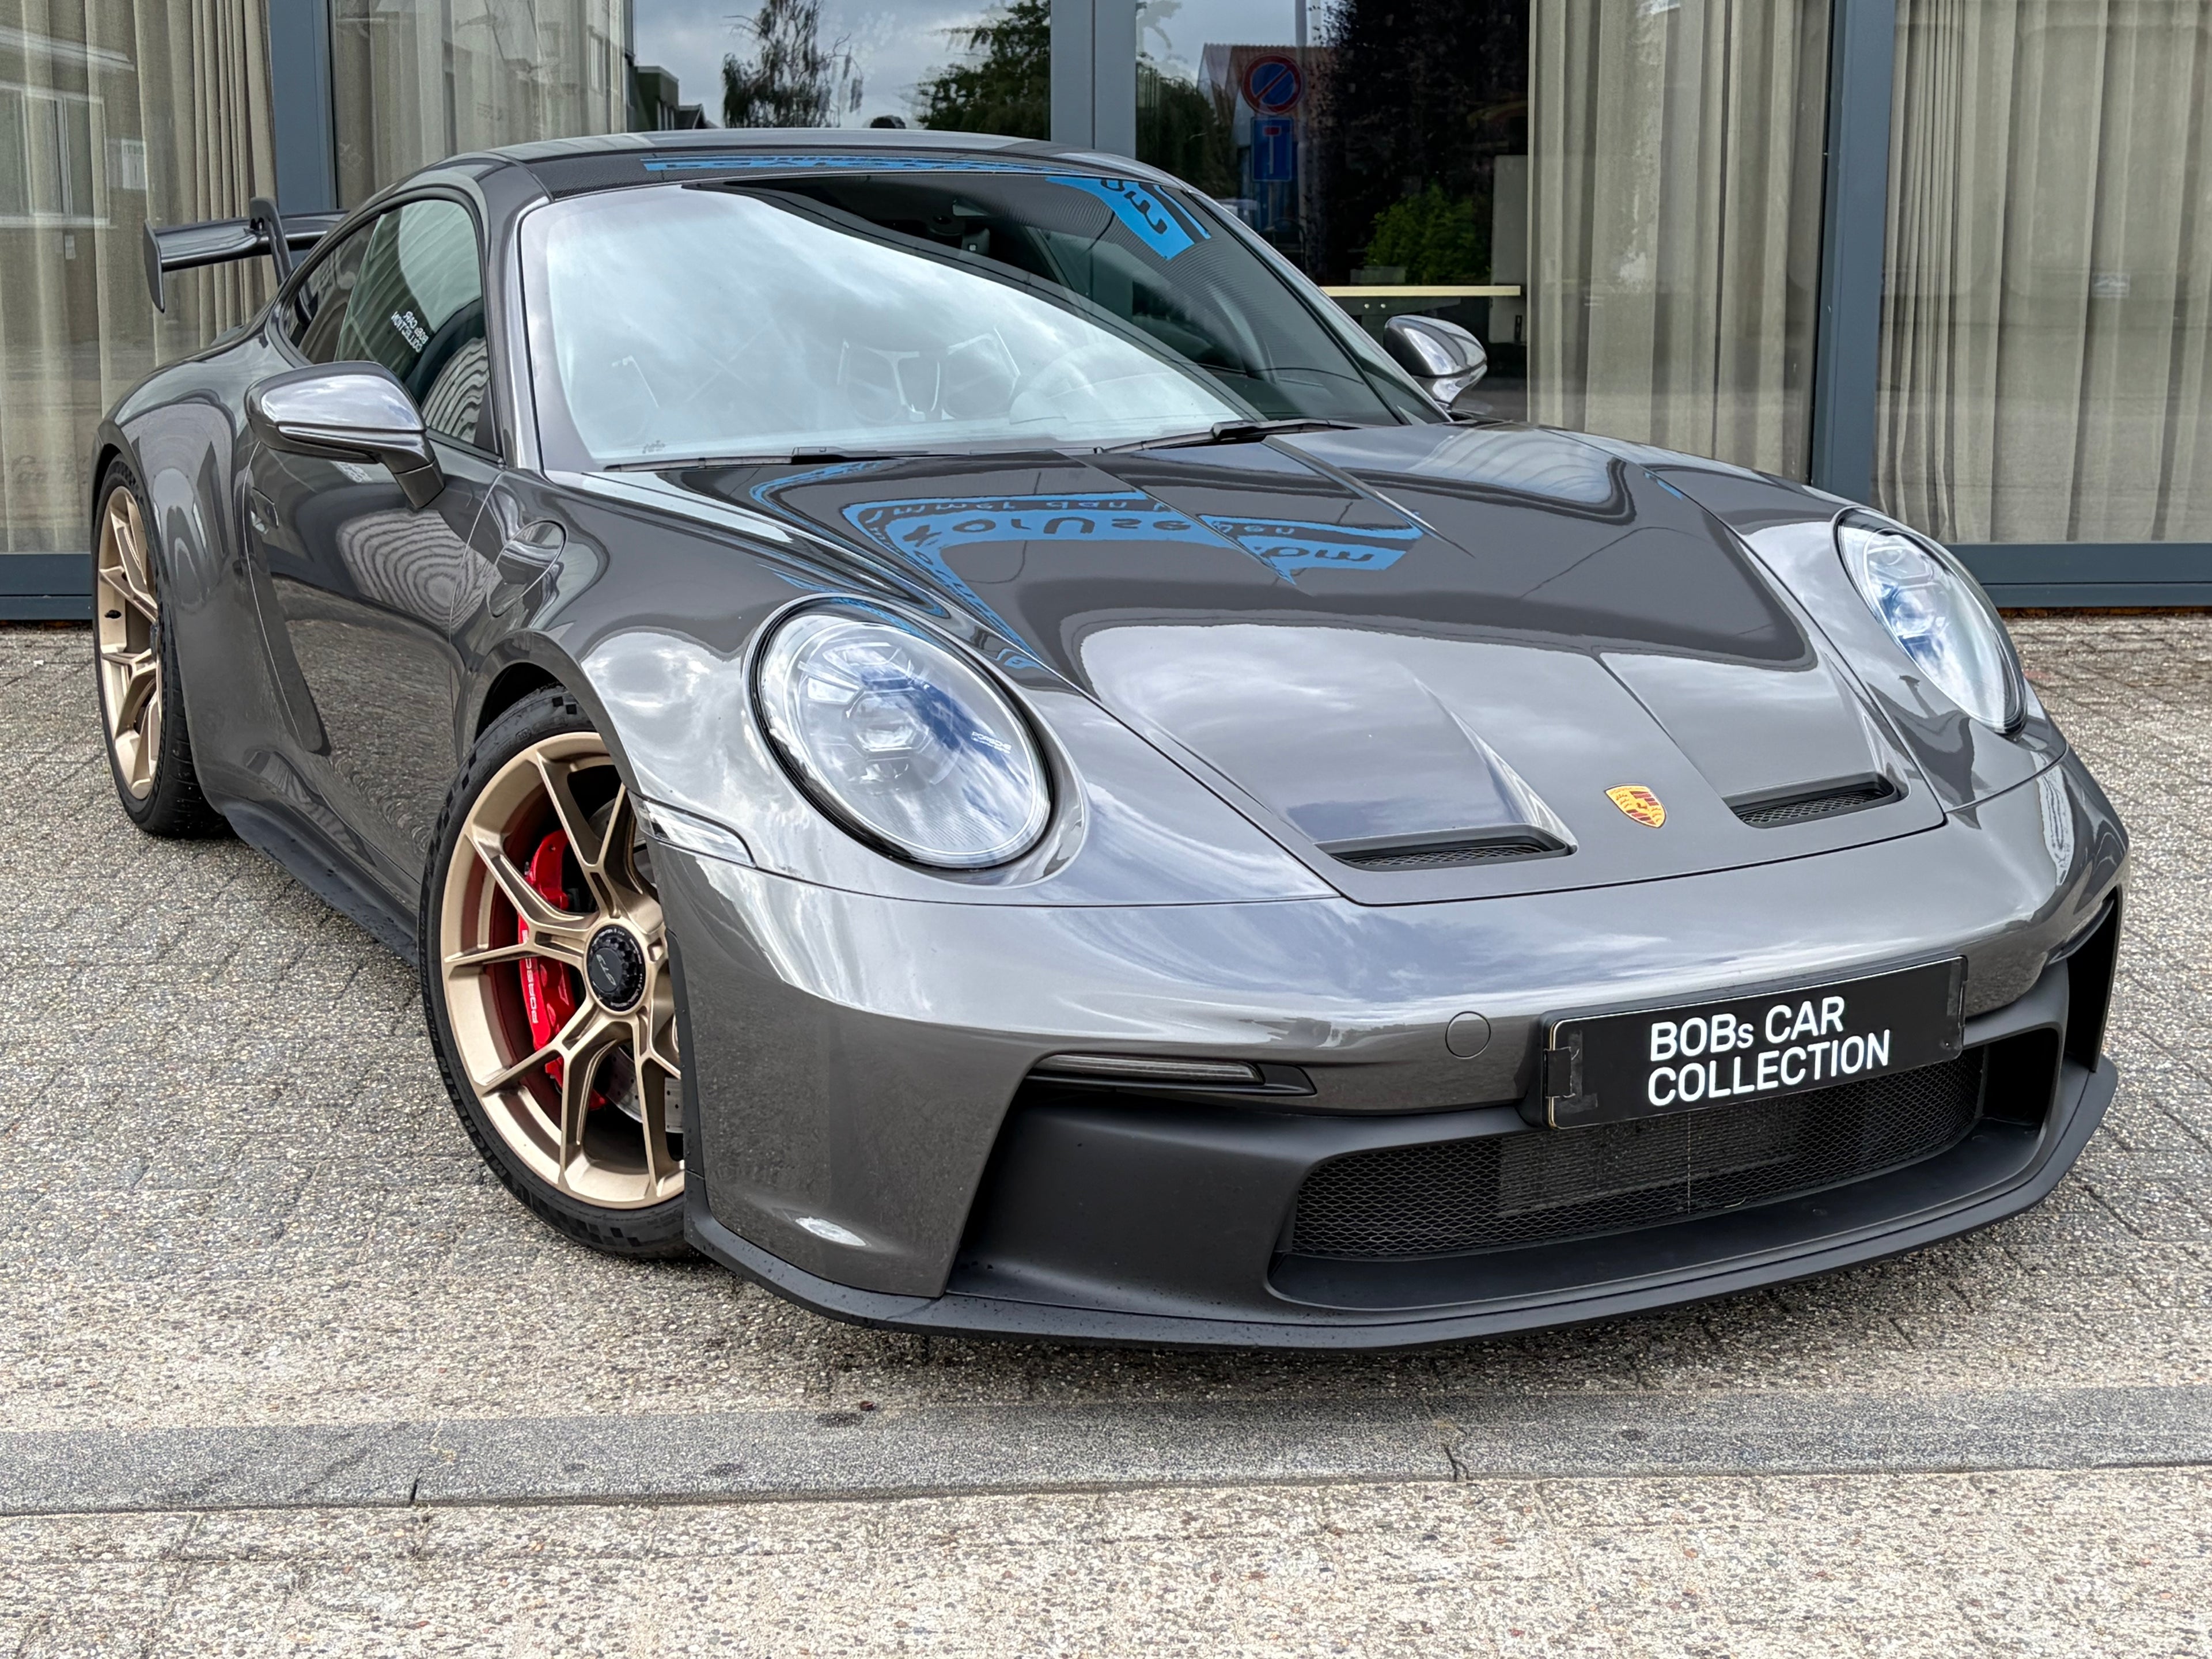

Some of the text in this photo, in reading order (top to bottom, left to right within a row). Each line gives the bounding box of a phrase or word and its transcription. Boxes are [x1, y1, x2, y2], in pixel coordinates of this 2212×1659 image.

[521, 929, 539, 1024] PORSCE
[1647, 1029, 1891, 1106] COLLECTION
[1650, 996, 1844, 1061] BOBs CAR
[438, 1056, 508, 1177] MICHELIN
